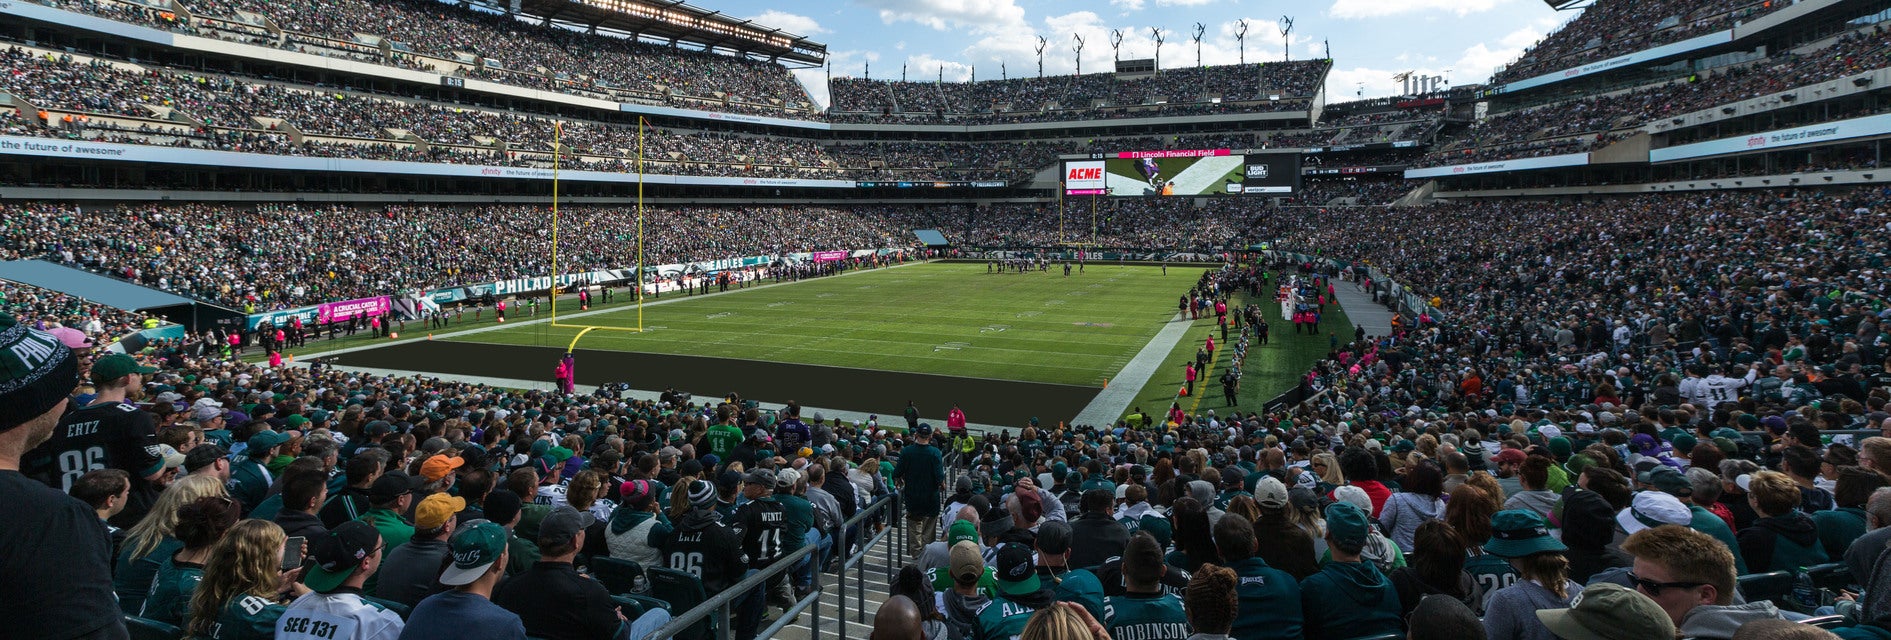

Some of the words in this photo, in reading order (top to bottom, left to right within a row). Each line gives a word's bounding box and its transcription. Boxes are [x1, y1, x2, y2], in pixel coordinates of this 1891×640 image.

[1, 141, 20, 149] the
[24, 142, 58, 151] future
[1068, 168, 1102, 180] ACME
[710, 257, 743, 270] EAGLES
[338, 303, 361, 312] CRUCIAL
[361, 301, 378, 309] CATCH
[1711, 388, 1727, 400] 11
[67, 420, 100, 437] ERTZ
[712, 438, 725, 452] 11
[761, 511, 782, 521] WENTZ
[757, 528, 782, 560] 11
[284, 617, 309, 633] SEC
[310, 620, 338, 640] 131
[1115, 622, 1188, 640] ROBINSON
